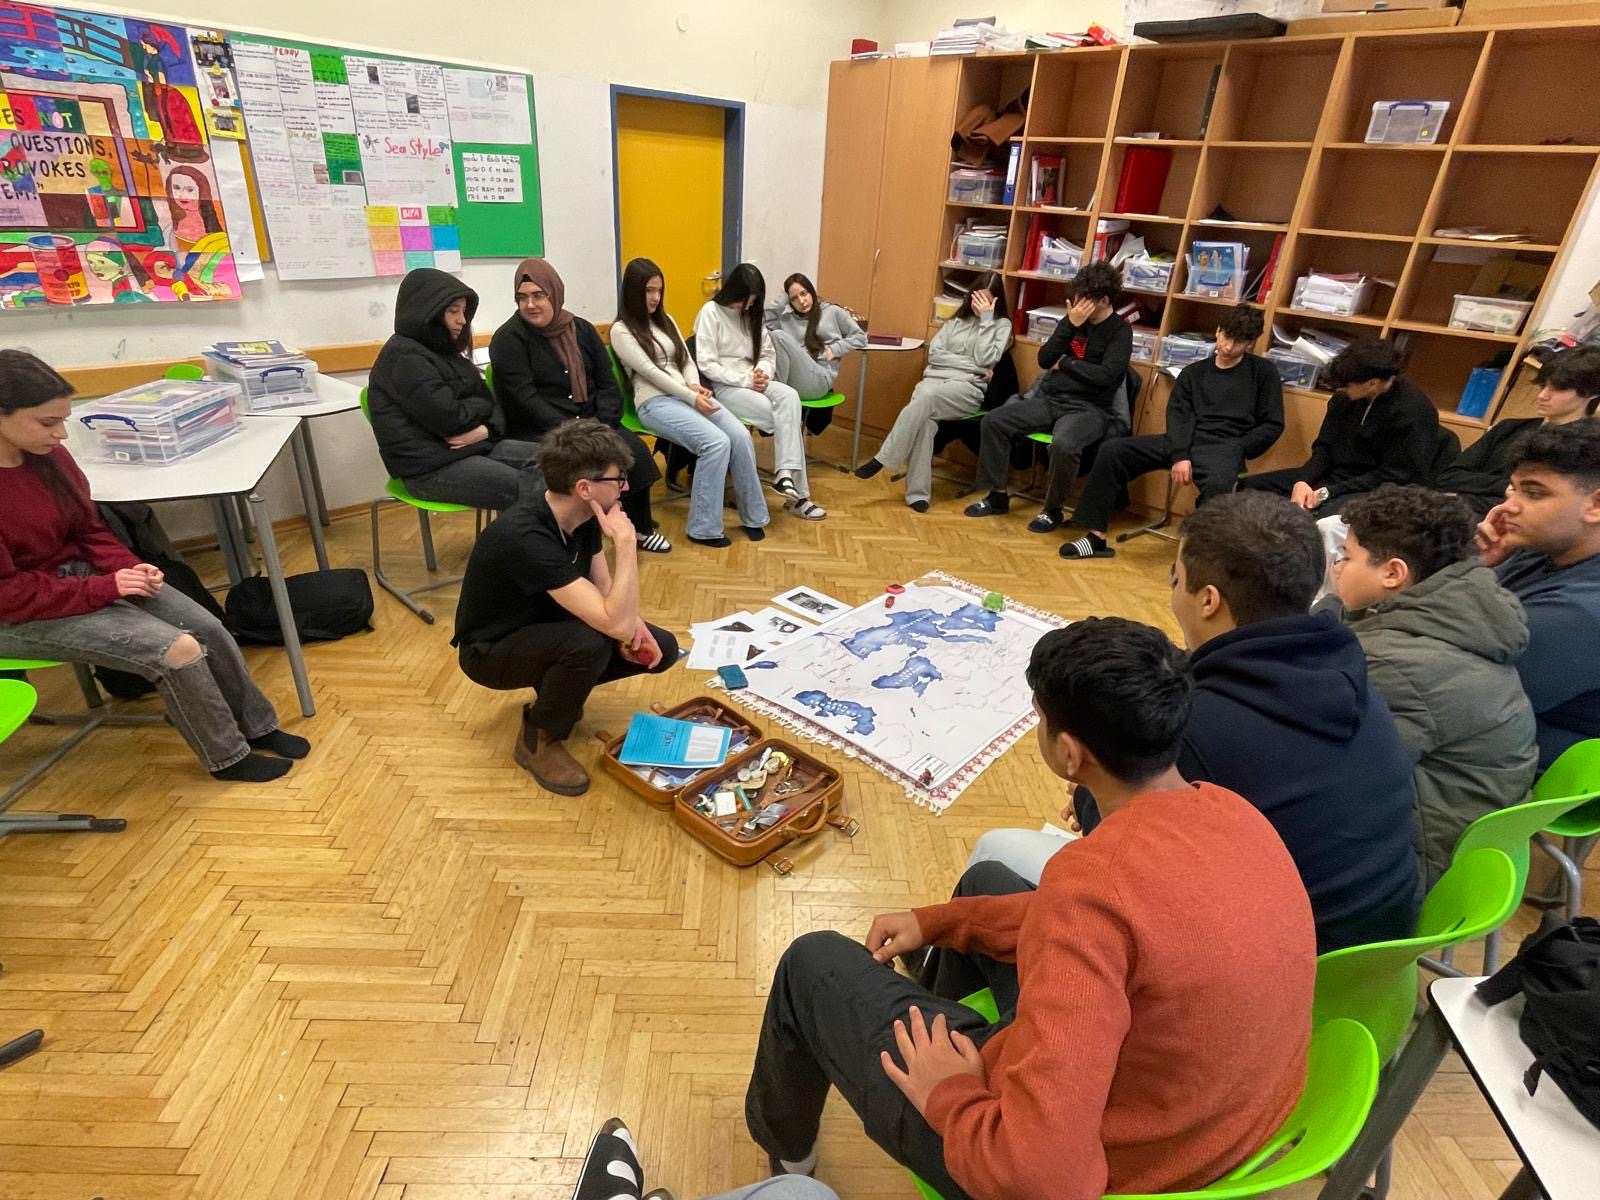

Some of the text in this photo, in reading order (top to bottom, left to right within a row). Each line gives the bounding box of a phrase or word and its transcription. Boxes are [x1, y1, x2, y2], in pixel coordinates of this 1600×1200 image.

[37, 111, 73, 129] NOT
[10, 133, 113, 159] QUESTIONS,
[384, 136, 407, 154] Sea
[409, 135, 441, 160] Style
[0, 157, 86, 178] ROVOKES
